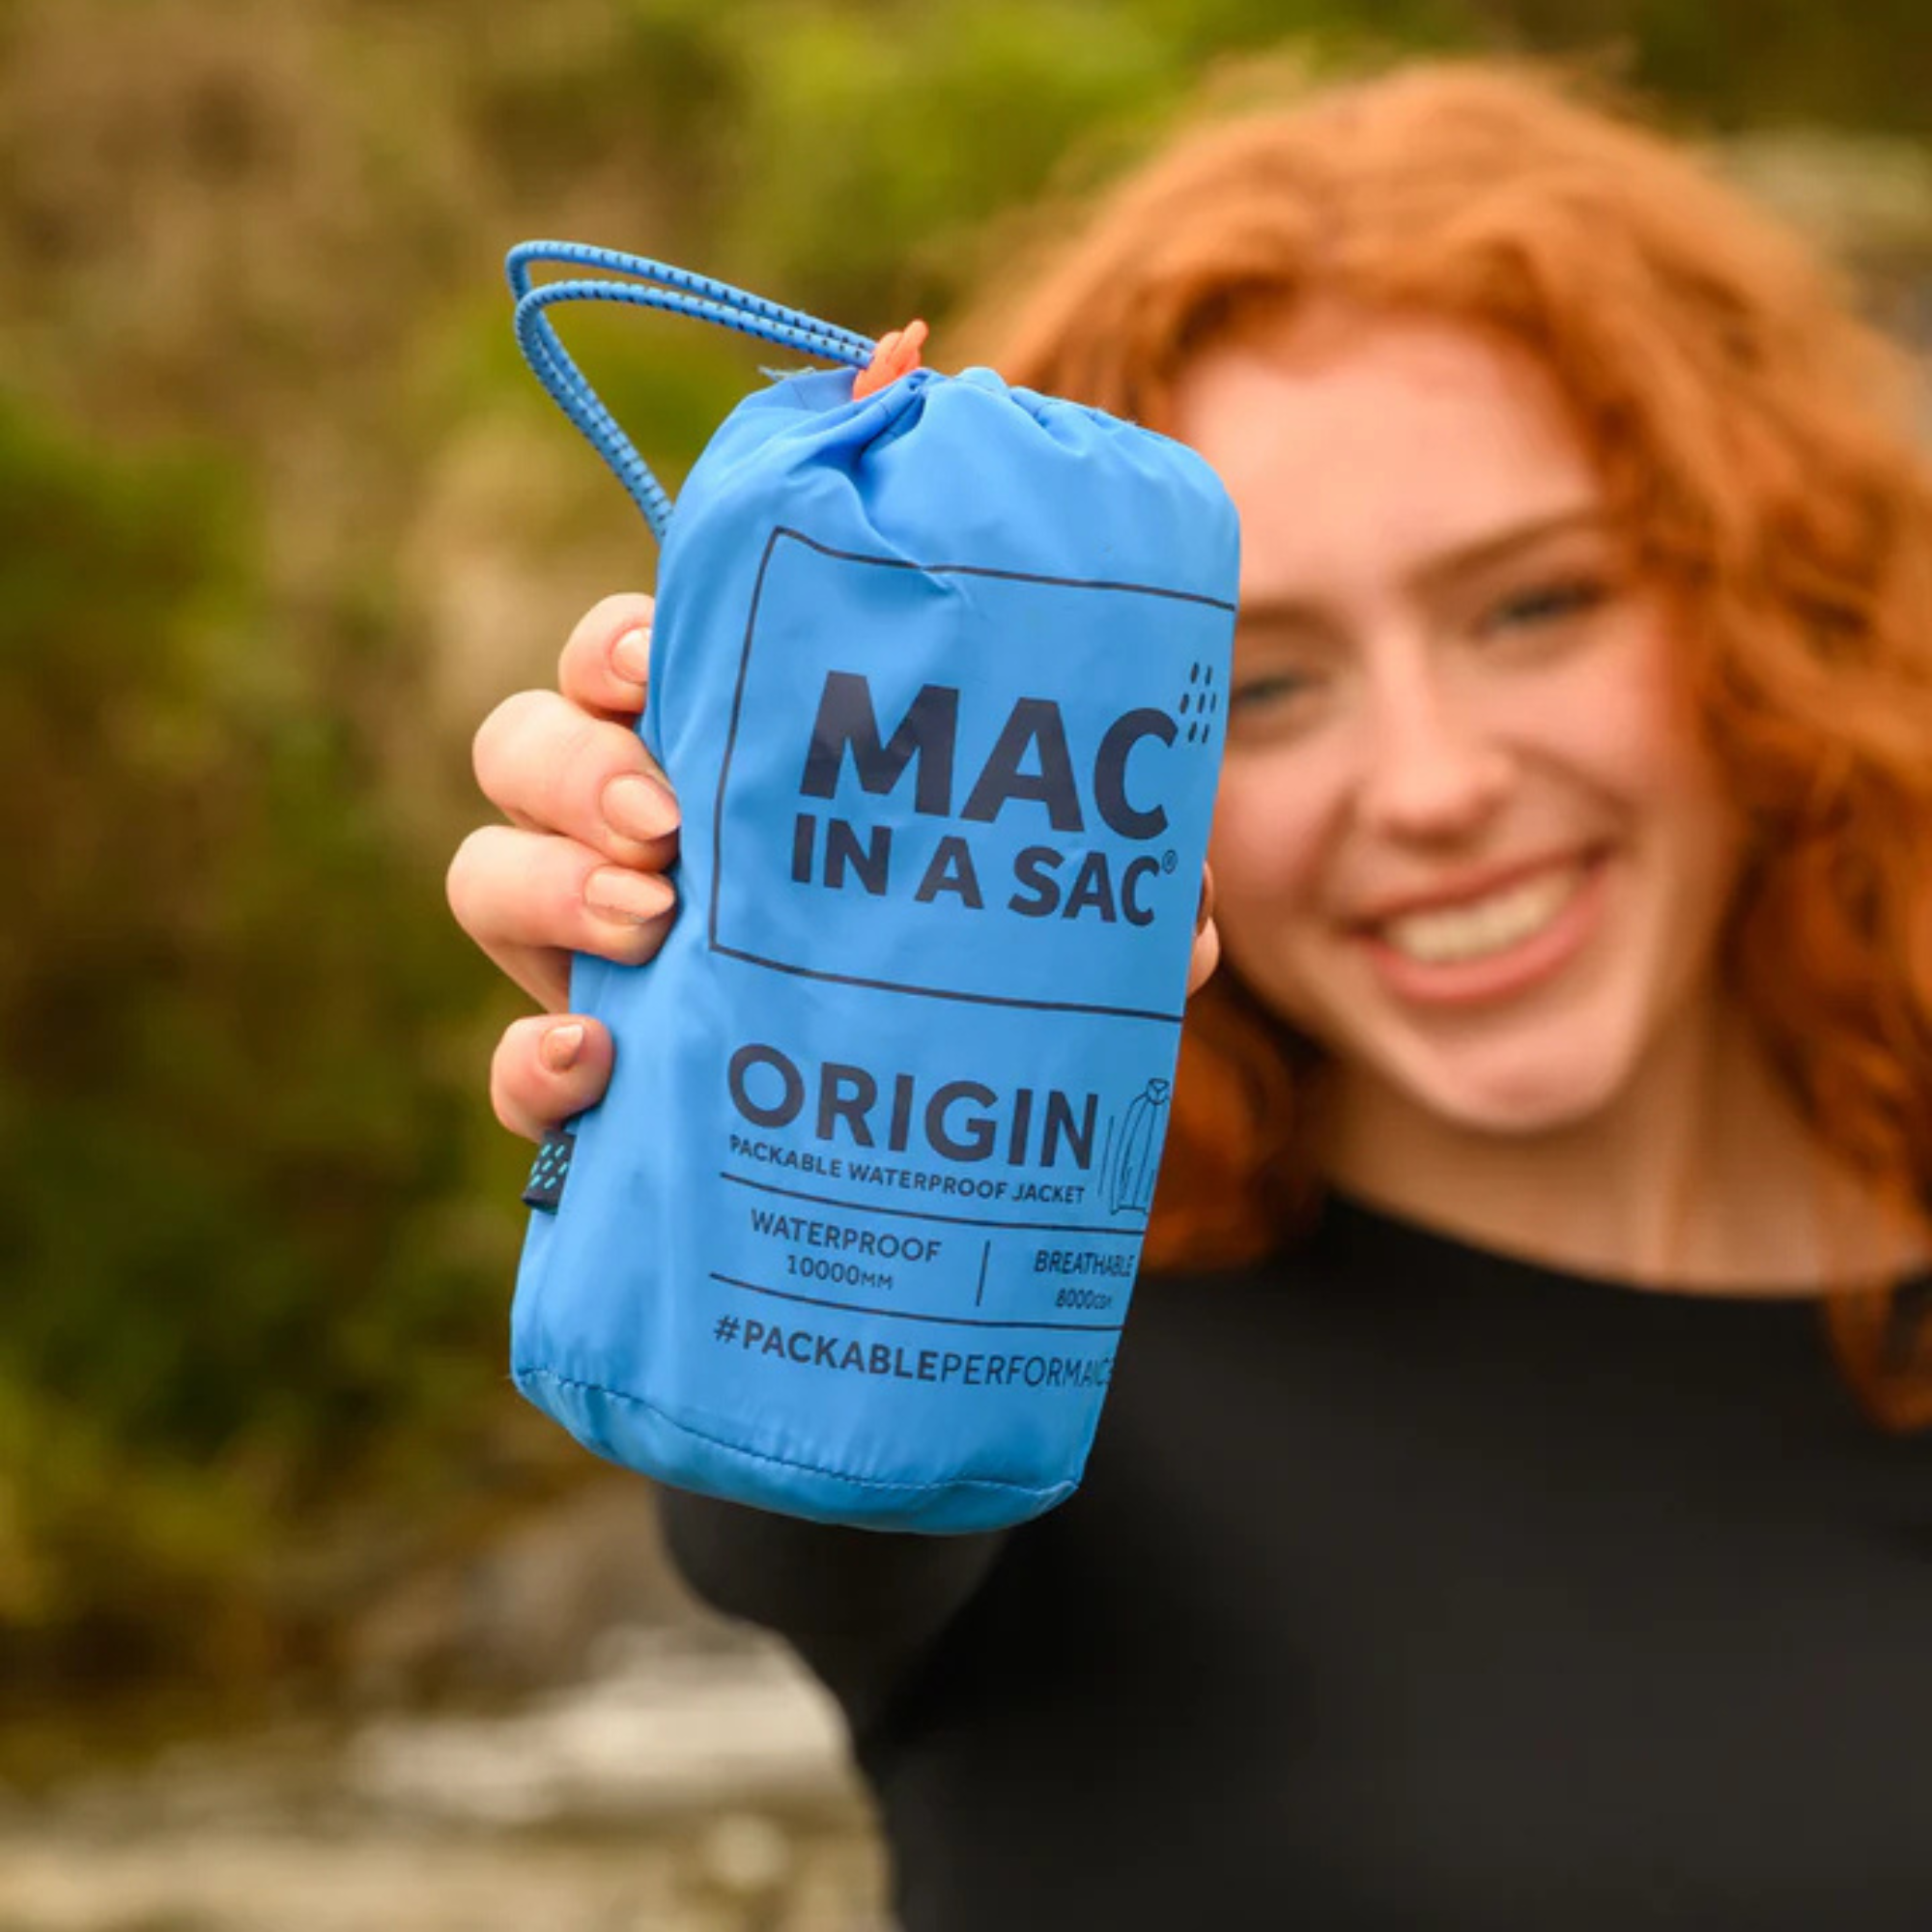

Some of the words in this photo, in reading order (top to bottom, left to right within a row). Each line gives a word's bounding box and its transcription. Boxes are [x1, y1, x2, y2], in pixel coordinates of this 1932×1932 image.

[800, 669, 1179, 840] MAC
[791, 812, 893, 896] IN
[914, 835, 983, 910] A
[727, 1042, 1099, 1171] ORIGIN
[729, 1133, 843, 1179] PACKABLE
[847, 1161, 1009, 1200] WATERPROOF
[1010, 1182, 1086, 1205] JACKET
[750, 1208, 943, 1264] WATERPROOF
[1034, 1249, 1135, 1278] BREATHABLE
